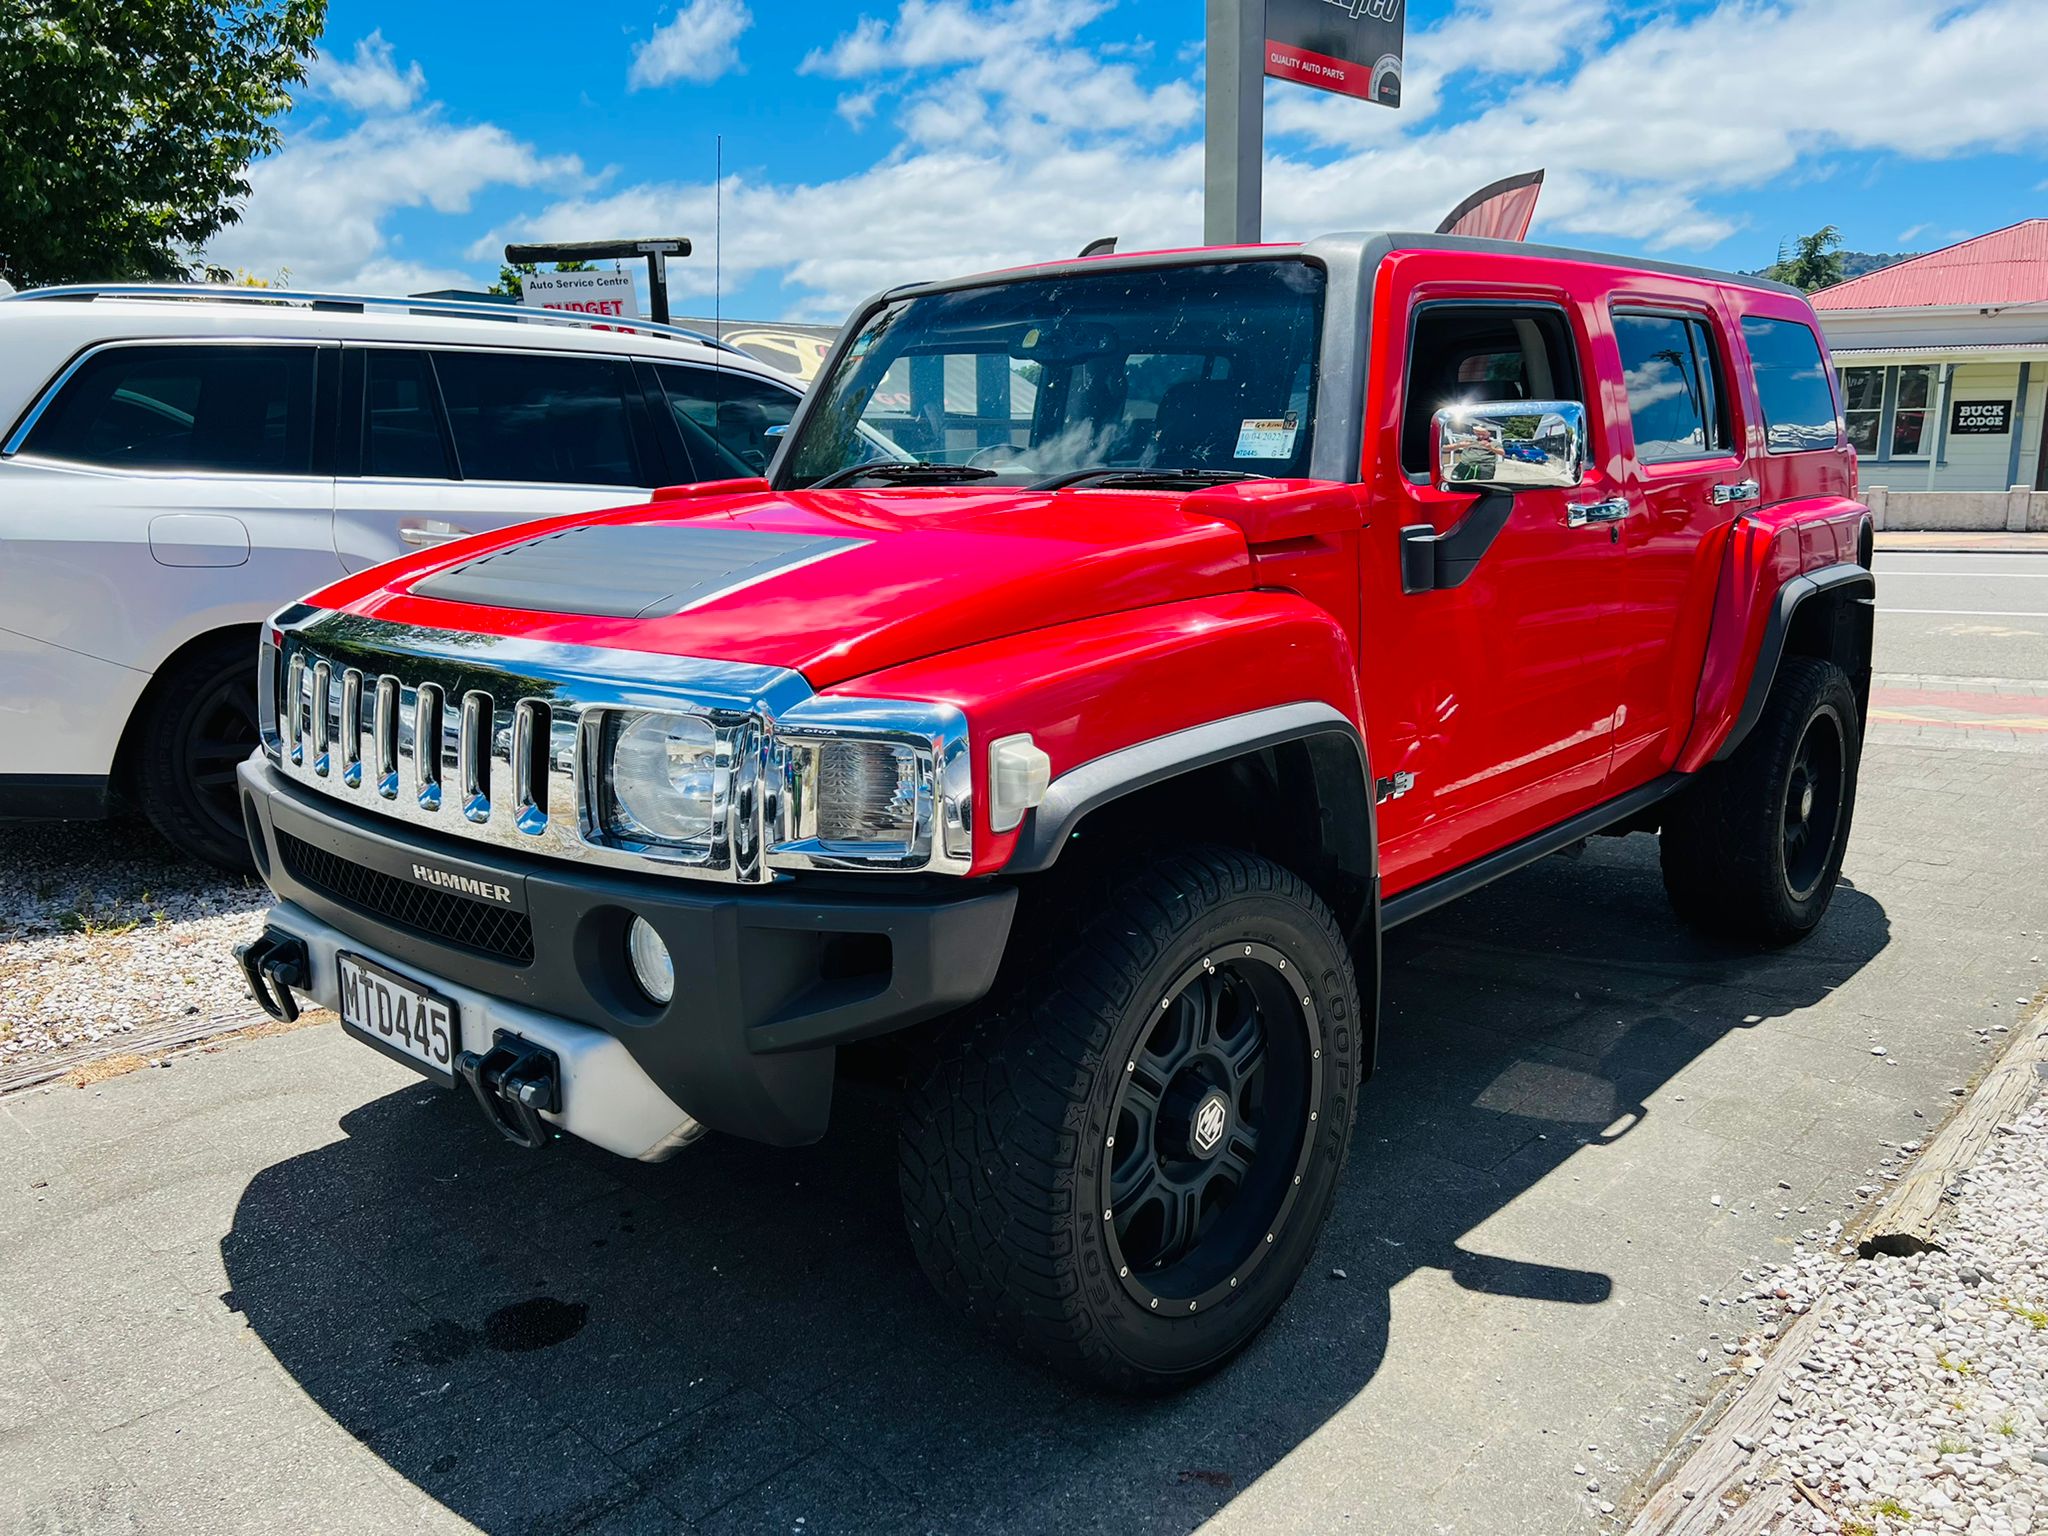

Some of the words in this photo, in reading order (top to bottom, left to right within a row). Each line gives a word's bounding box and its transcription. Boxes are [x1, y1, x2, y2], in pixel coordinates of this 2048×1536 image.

[1271, 53, 1300, 69] QUALITY
[1302, 61, 1321, 74] AUTO
[1322, 68, 1345, 80] PARTS
[529, 281, 553, 290] Auto
[556, 279, 594, 289] Service
[597, 277, 629, 287] Centre
[1959, 417, 2003, 426] LODGE
[1960, 405, 2004, 416] BUCK
[411, 863, 512, 903] HUMMER
[343, 965, 450, 1065] MTD445
[1321, 968, 1350, 1164] COOPER
